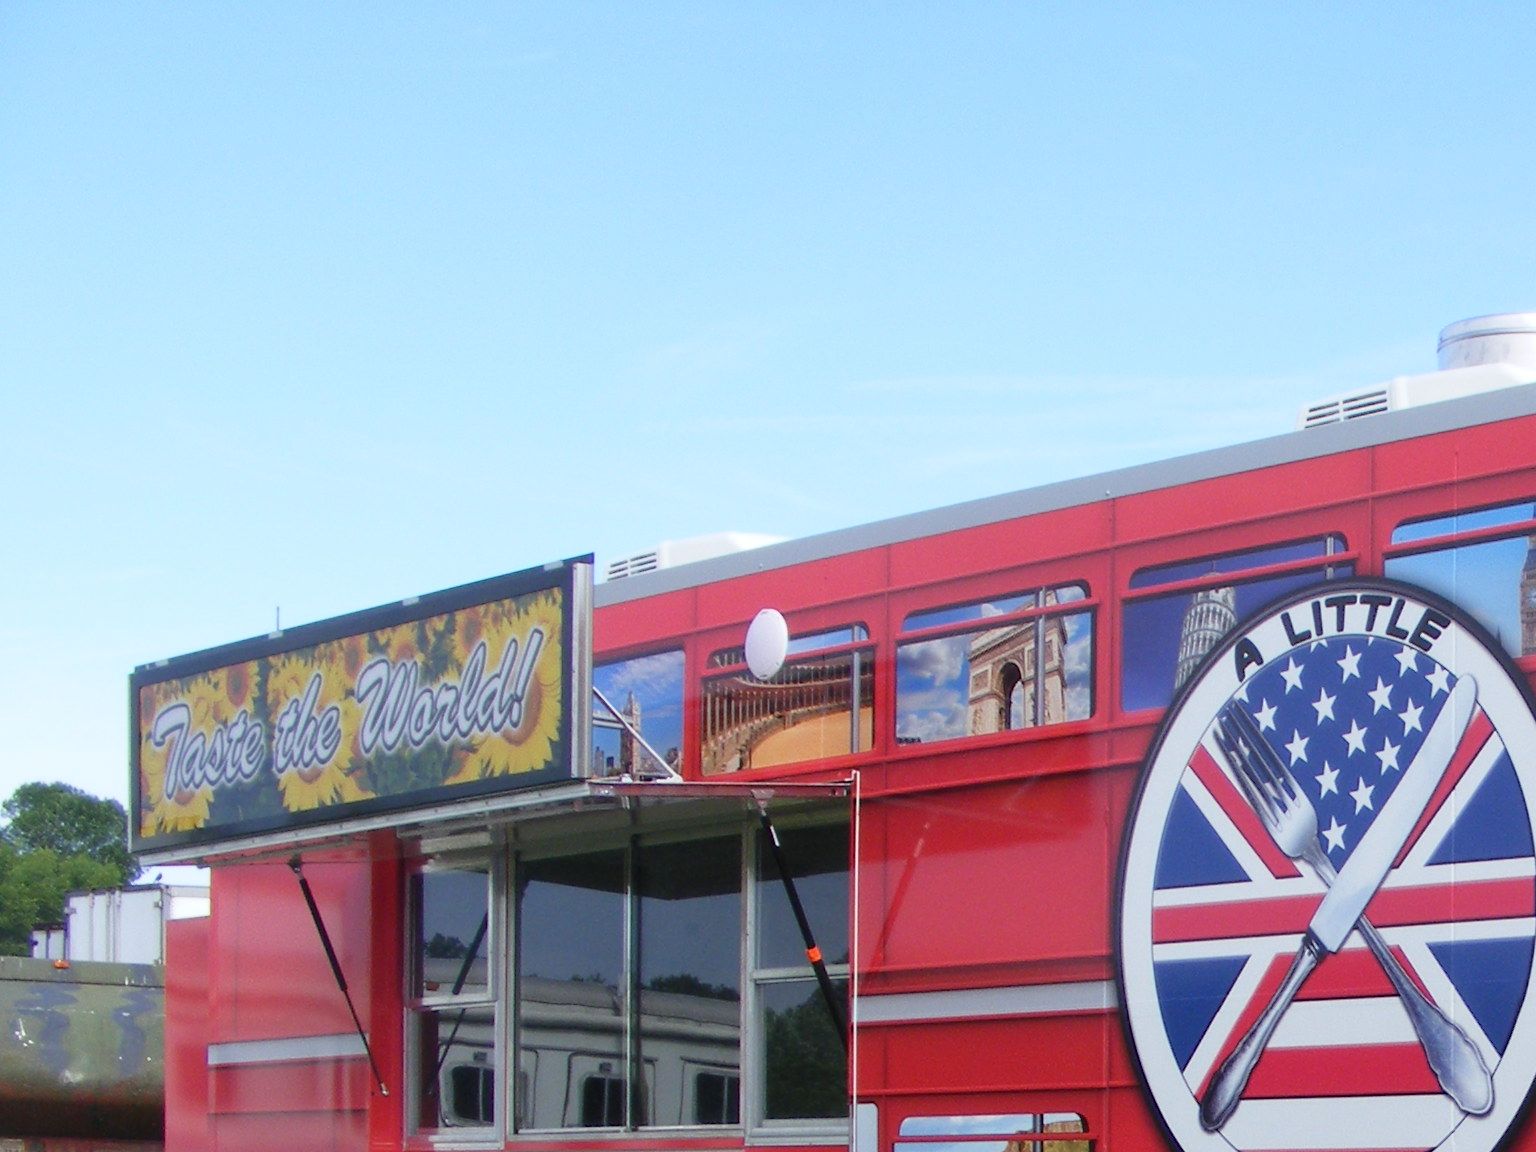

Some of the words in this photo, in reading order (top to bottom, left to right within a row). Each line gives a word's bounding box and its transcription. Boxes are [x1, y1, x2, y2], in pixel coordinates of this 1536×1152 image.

[1233, 643, 1264, 682] A
[1280, 594, 1450, 653] LITTLE
[153, 701, 265, 799] Taste
[274, 673, 342, 775] the
[354, 628, 545, 755] World!
